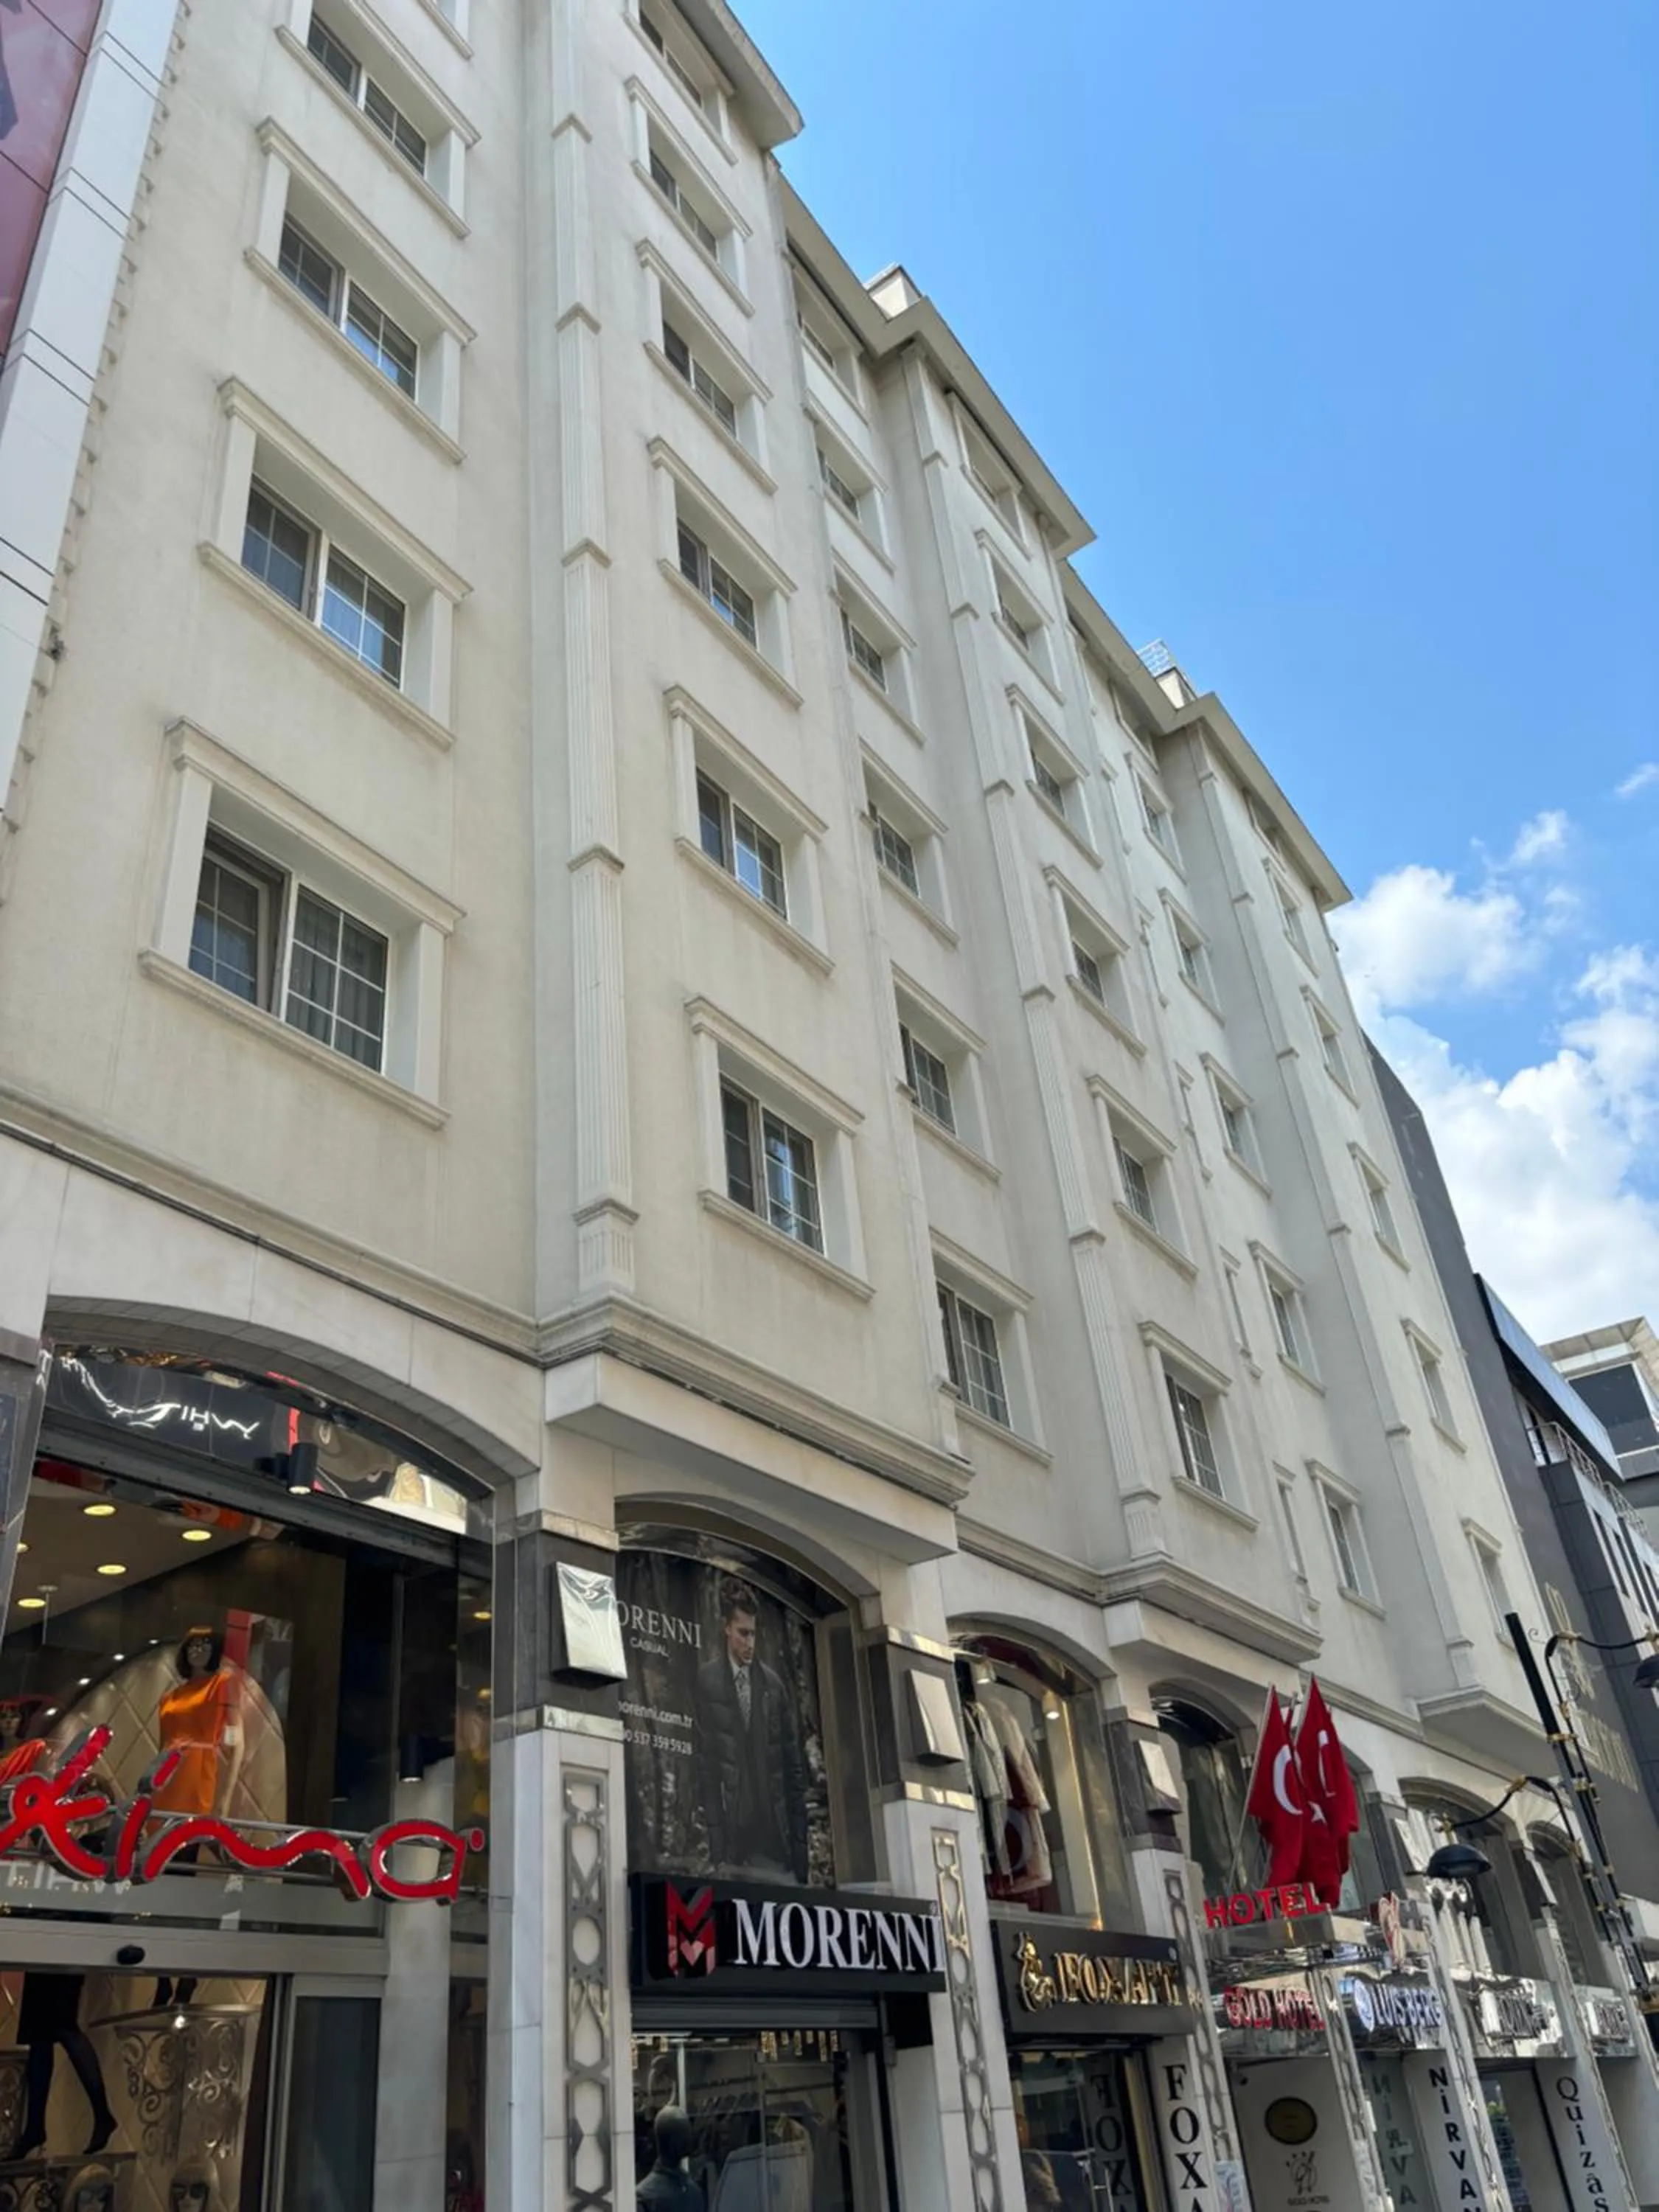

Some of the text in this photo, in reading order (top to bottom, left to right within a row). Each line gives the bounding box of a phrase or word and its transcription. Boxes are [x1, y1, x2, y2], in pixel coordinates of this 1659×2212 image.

[615, 1600, 701, 1649] ORENNI
[1203, 1882, 1326, 1929] HOTEL
[732, 1899, 946, 1972] MORENNI
[1224, 1986, 1326, 2031] GOLD HOTEL
